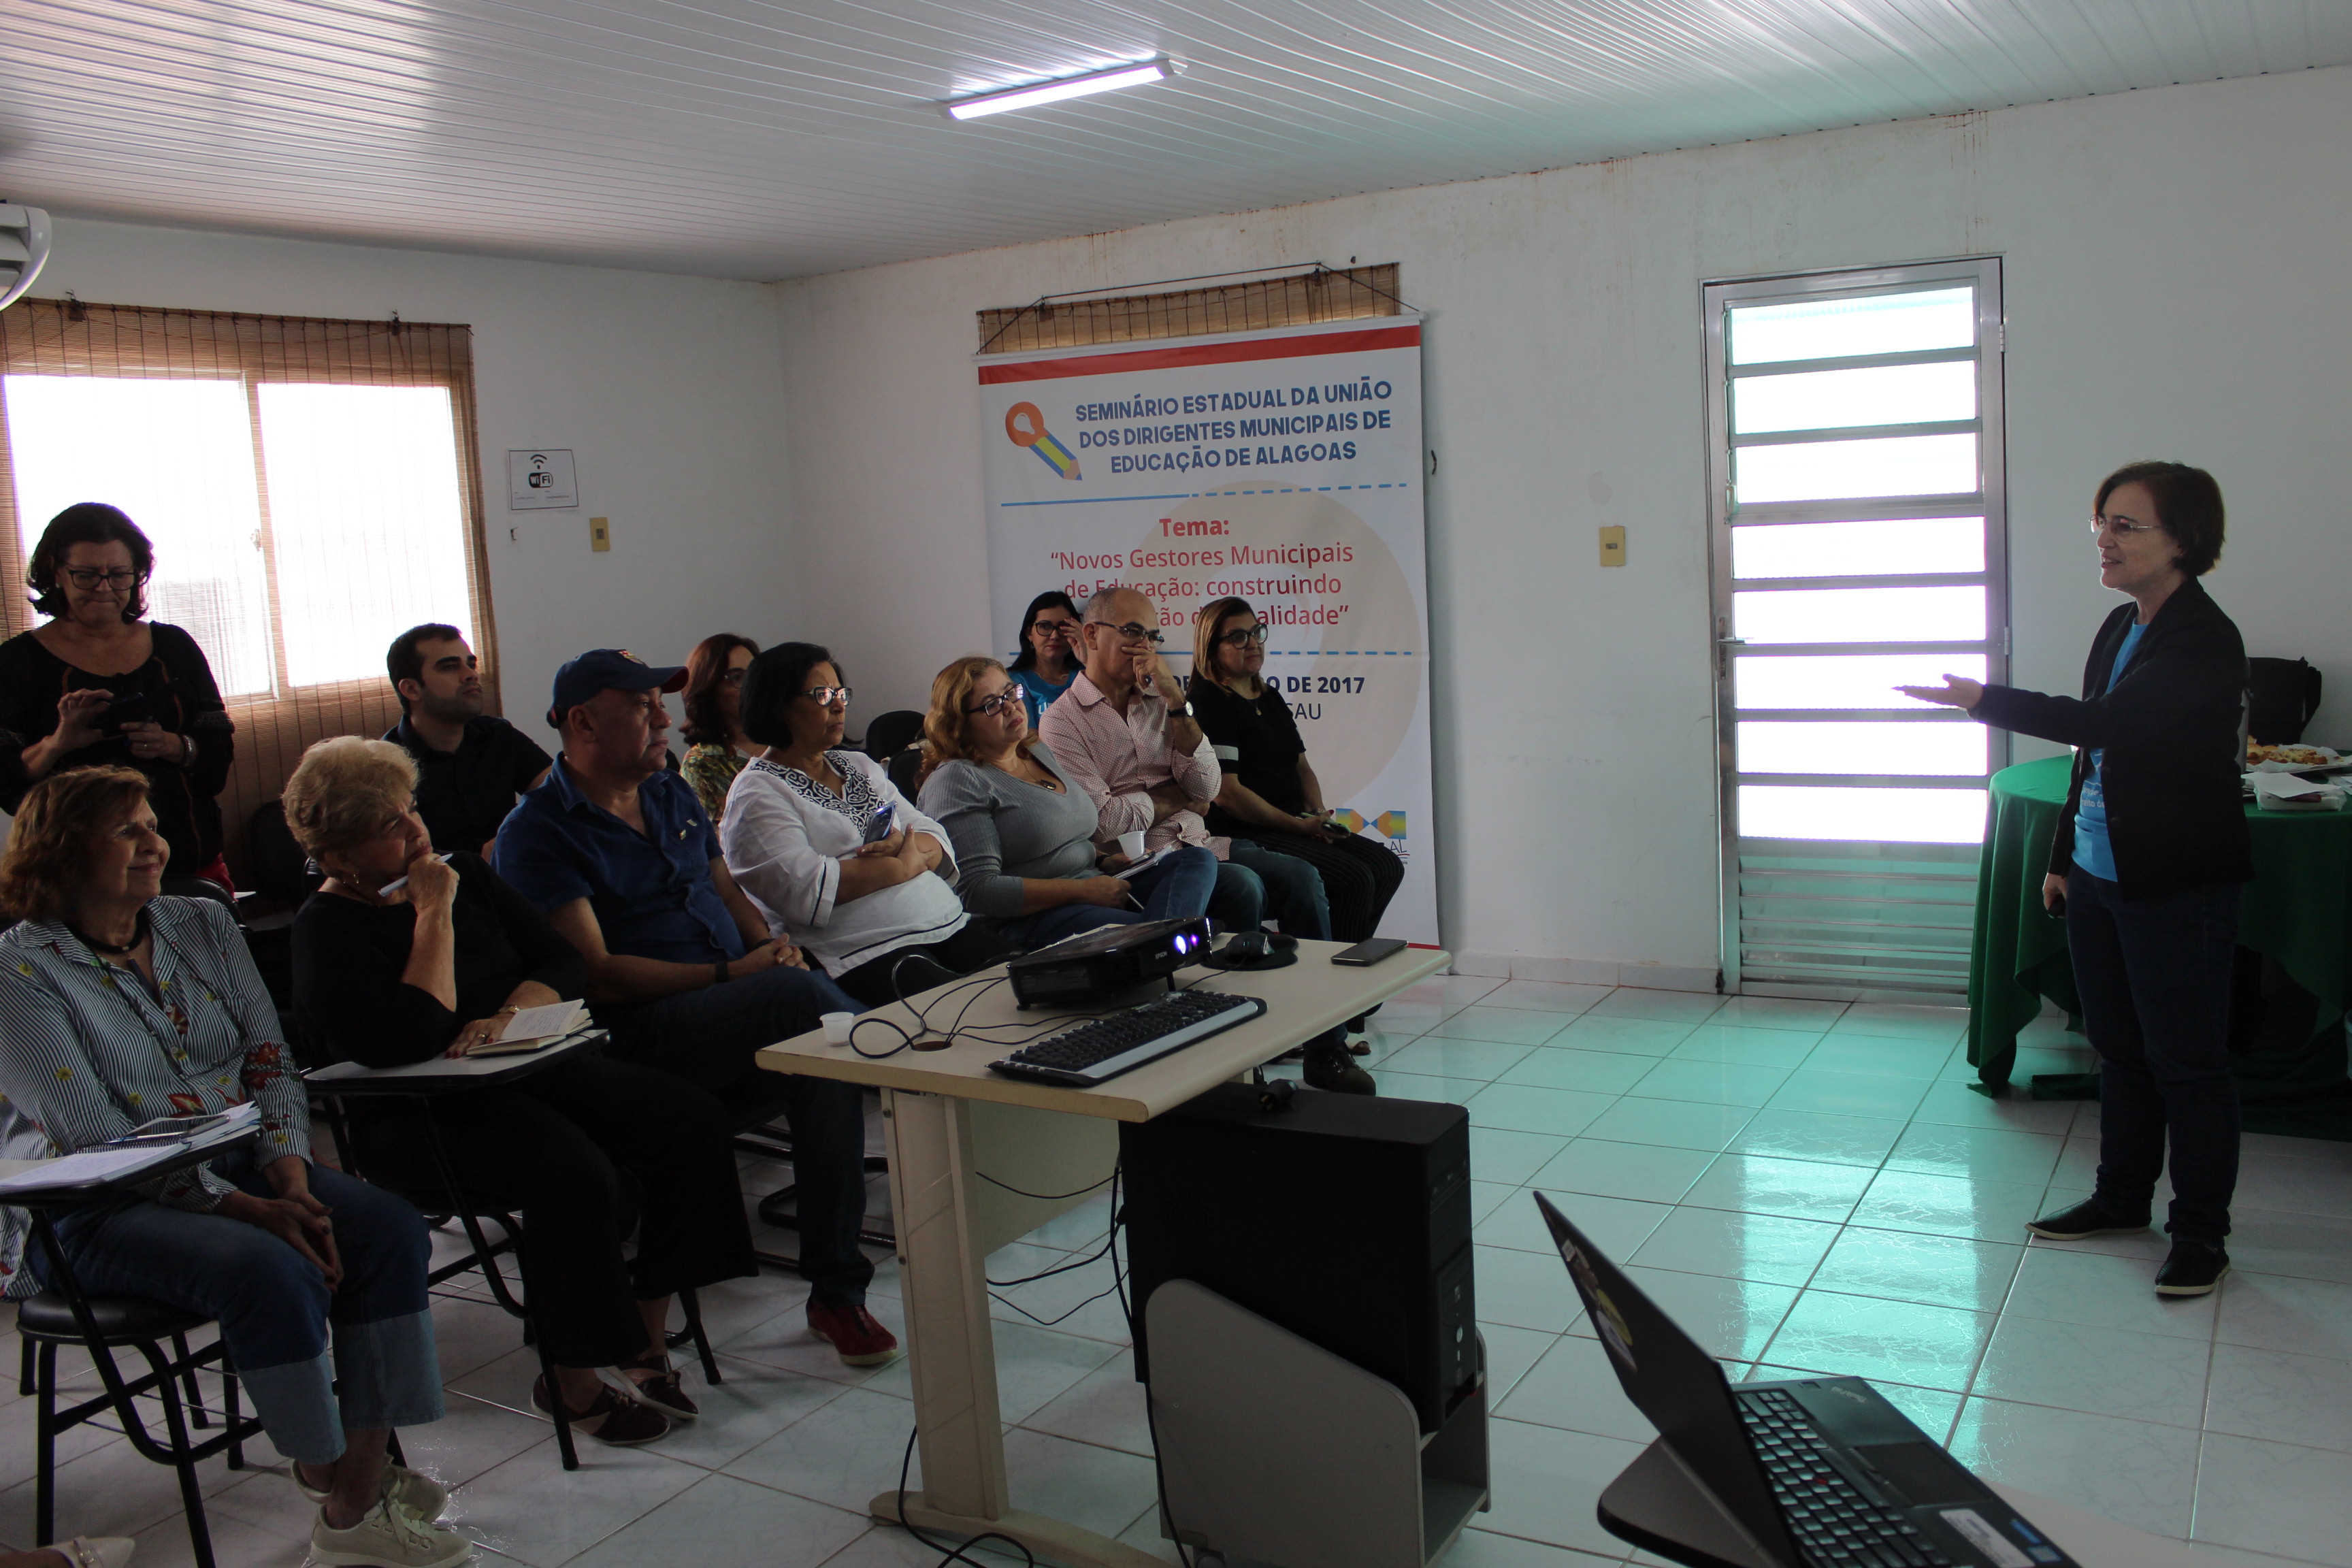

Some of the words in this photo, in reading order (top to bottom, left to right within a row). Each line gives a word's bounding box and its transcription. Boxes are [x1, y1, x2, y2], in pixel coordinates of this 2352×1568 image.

[1075, 394, 1179, 421] SEMINÁRIO
[1183, 389, 1287, 414] ESTADUAL
[1291, 386, 1320, 406] DA
[1324, 376, 1392, 403] UNIÃO
[1079, 429, 1120, 448] DOS
[1124, 421, 1236, 445] DIRIGENTES
[1240, 412, 1358, 438] MUNICIPAIS
[1363, 410, 1391, 429] DE
[1111, 445, 1221, 473] EDUCAÇÃO
[1226, 447, 1251, 466] DE
[1256, 441, 1356, 465] ALAGOAS
[1159, 518, 1230, 537] Tema:
[1130, 548, 1224, 568] Gestores
[1231, 542, 1354, 569] Municipais
[1064, 579, 1089, 599] de
[1207, 573, 1341, 596] construindo
[1287, 676, 1311, 693] DE
[1318, 676, 1365, 694] 2017
